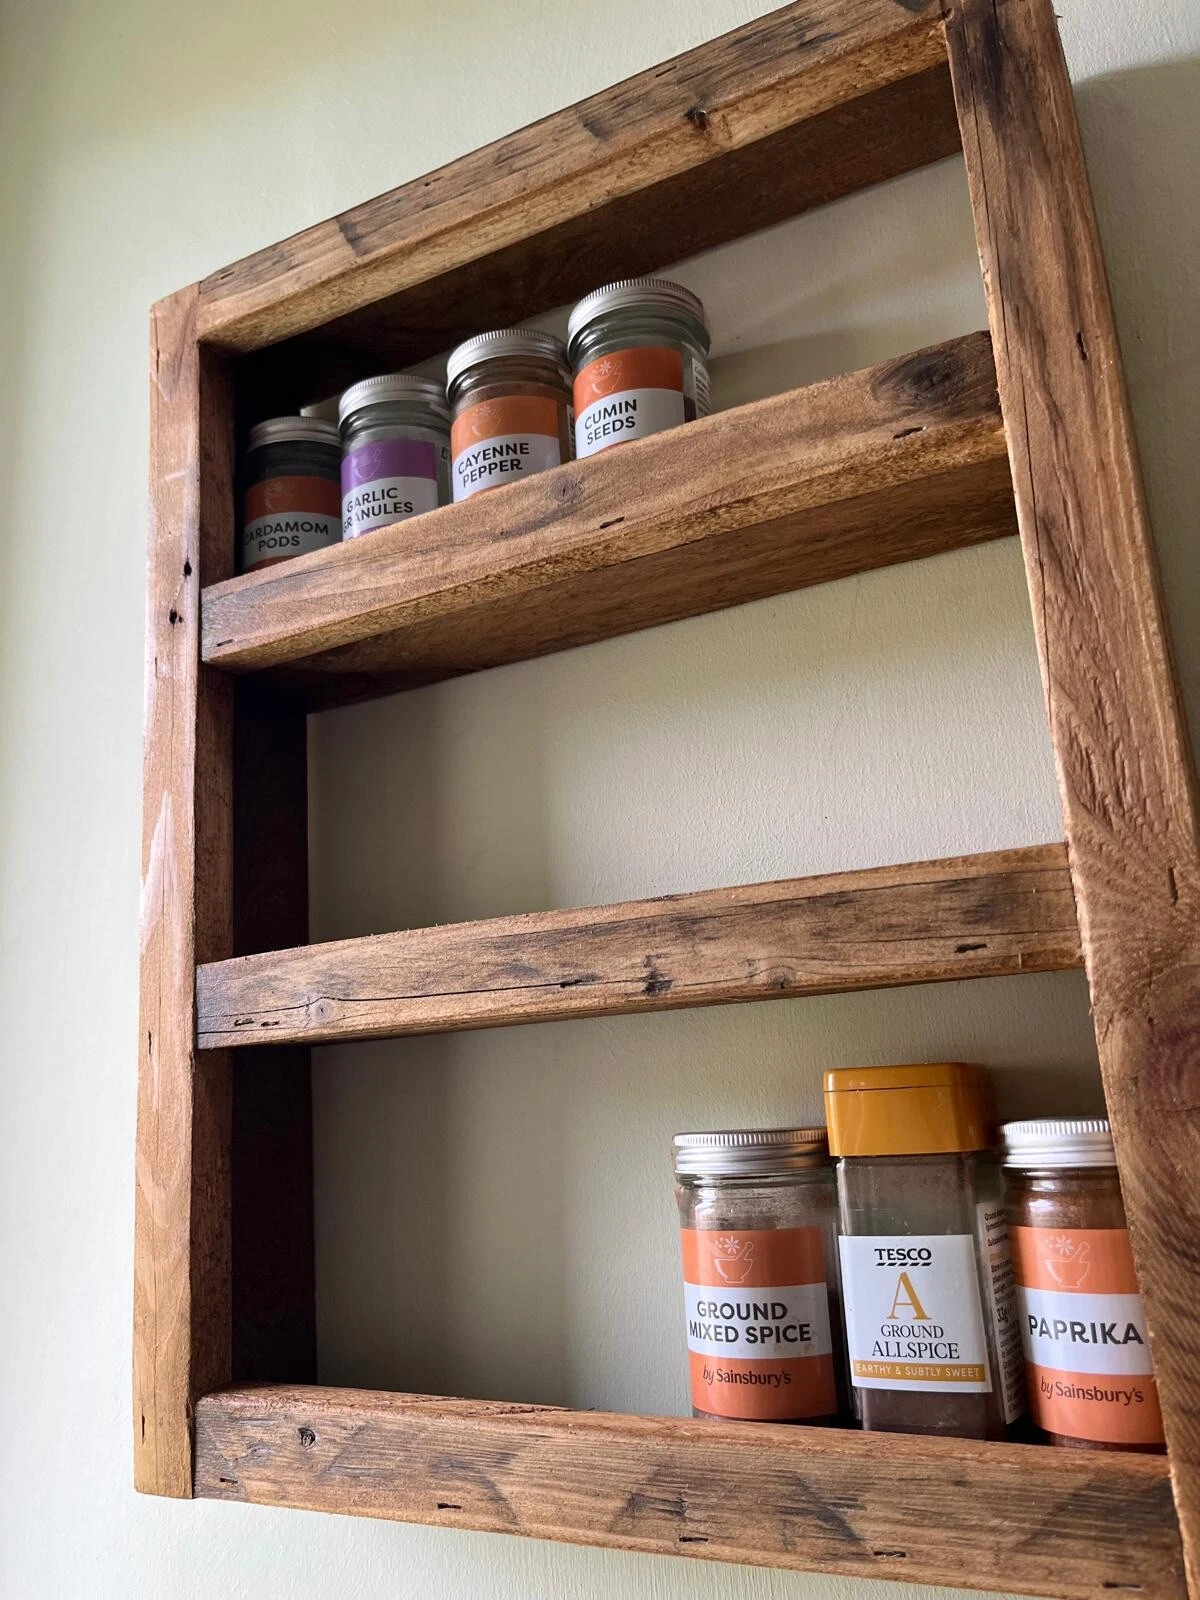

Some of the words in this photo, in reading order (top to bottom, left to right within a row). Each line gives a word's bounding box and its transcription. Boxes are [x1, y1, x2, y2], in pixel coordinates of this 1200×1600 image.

[584, 399, 638, 430] CUMIN
[587, 416, 636, 445] SEEDS
[458, 442, 530, 475] CAYENNE
[463, 458, 523, 488] PEPPER
[347, 487, 398, 513] GARLIC
[343, 501, 413, 533] GRANULES
[243, 521, 329, 546] CARDAMOM
[258, 535, 300, 552] PODS
[874, 1248, 932, 1261] TESCO
[886, 1271, 932, 1320] A
[697, 1301, 788, 1321] GROUND
[689, 1320, 739, 1344] MIXED
[745, 1323, 812, 1344] SPICE
[881, 1324, 944, 1339] GROUND
[1028, 1314, 1144, 1345] PAPRIKA
[872, 1340, 960, 1360] ALLSPICE
[703, 1364, 714, 1386] by
[716, 1369, 792, 1388] Sainsbury's
[856, 1364, 892, 1375] EARTHY
[895, 1366, 901, 1375] &
[905, 1366, 941, 1377] SUBTLY
[945, 1367, 979, 1377] SWEET
[1040, 1376, 1053, 1400] by
[1055, 1381, 1144, 1406] Sainsbury's
